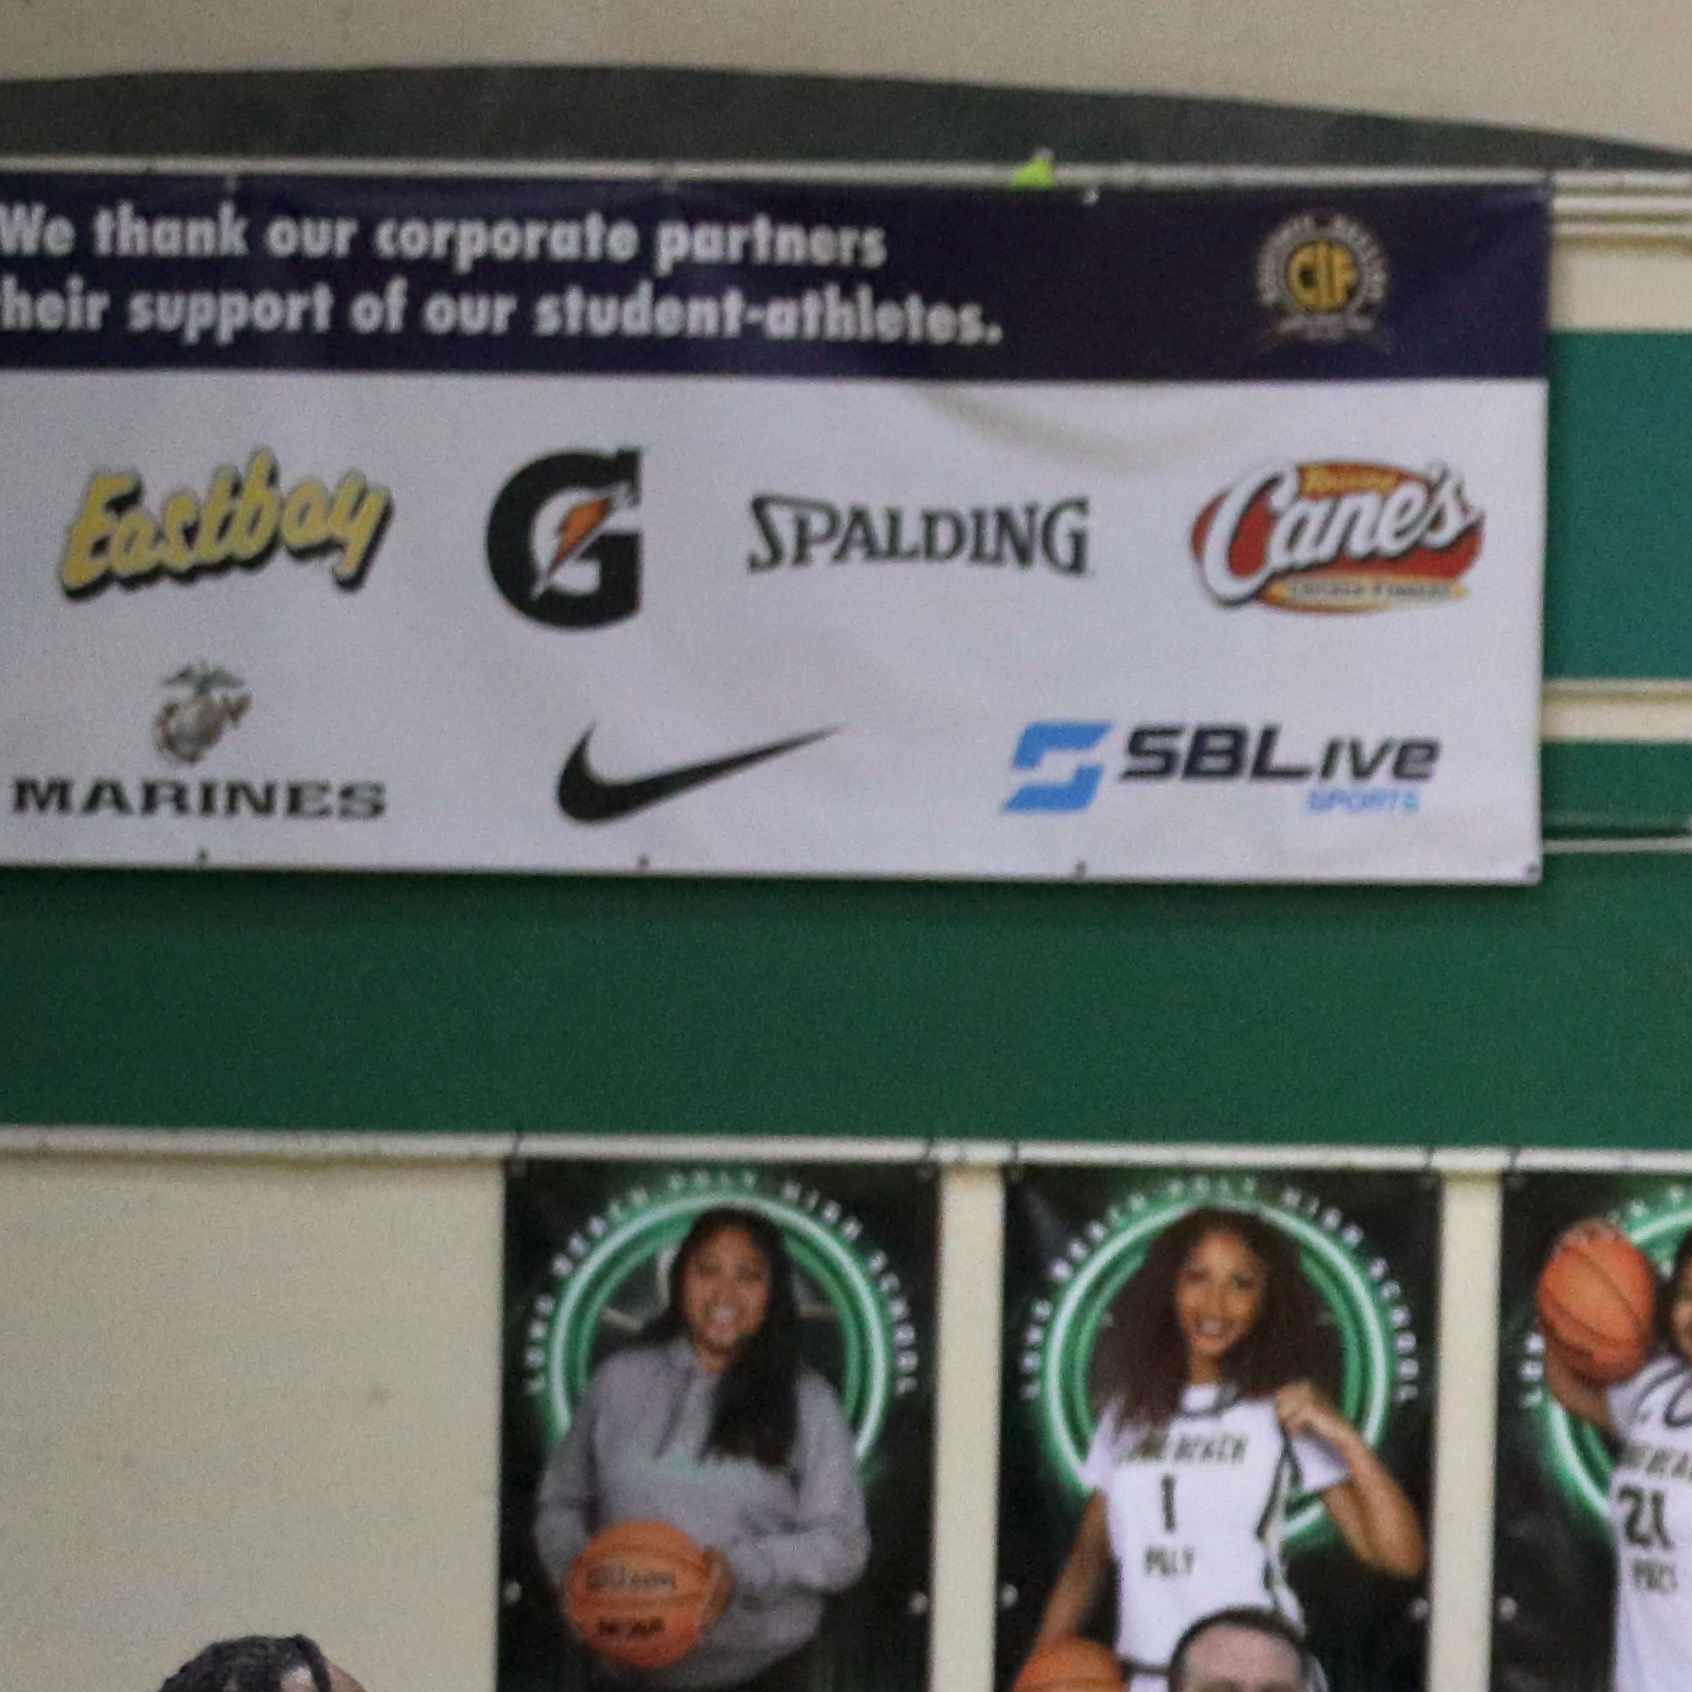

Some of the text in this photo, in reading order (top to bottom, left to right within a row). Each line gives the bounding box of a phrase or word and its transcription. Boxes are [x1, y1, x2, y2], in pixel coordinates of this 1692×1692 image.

[0, 201, 886, 275] We thank our corporate partners
[126, 281, 333, 345] support
[349, 273, 408, 334] of
[424, 291, 517, 336] our
[534, 280, 1003, 346] student-athletes.
[59, 447, 393, 602] Eastbay
[484, 446, 644, 633] G
[746, 492, 1094, 578] SPALDING
[1202, 458, 1485, 607] Cane's
[10, 775, 388, 820] MARINES
[1160, 1473, 1177, 1534] 1
[1618, 1483, 1674, 1550] 21
